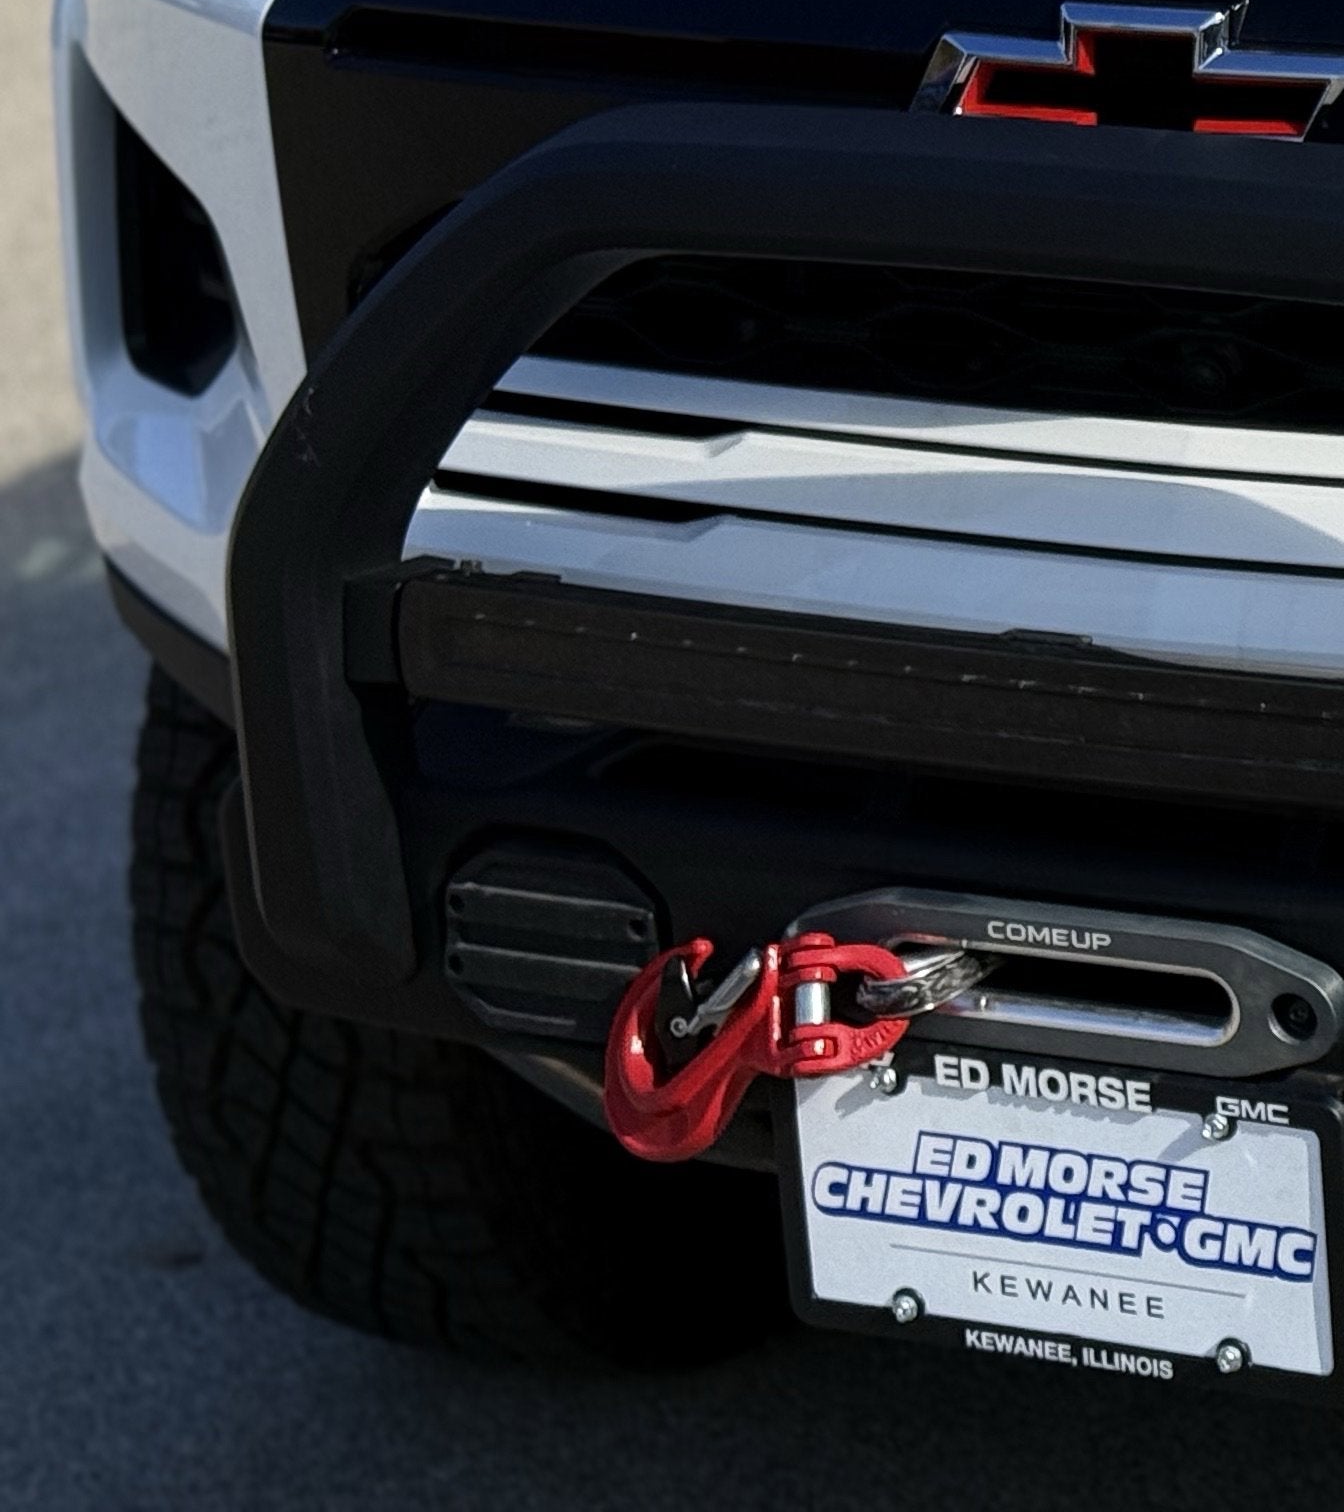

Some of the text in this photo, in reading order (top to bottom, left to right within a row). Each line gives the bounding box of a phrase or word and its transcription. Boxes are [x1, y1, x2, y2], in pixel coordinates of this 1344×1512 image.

[987, 920, 1112, 950] COMEUP
[934, 1054, 1152, 1113] ED MORSE
[1215, 1096, 1290, 1125] GMC
[913, 1130, 1209, 1213] ED MORSE
[972, 1271, 1165, 1319] KEWANEE
[965, 1328, 1173, 1379] KEWANEE, ILLINOIS
